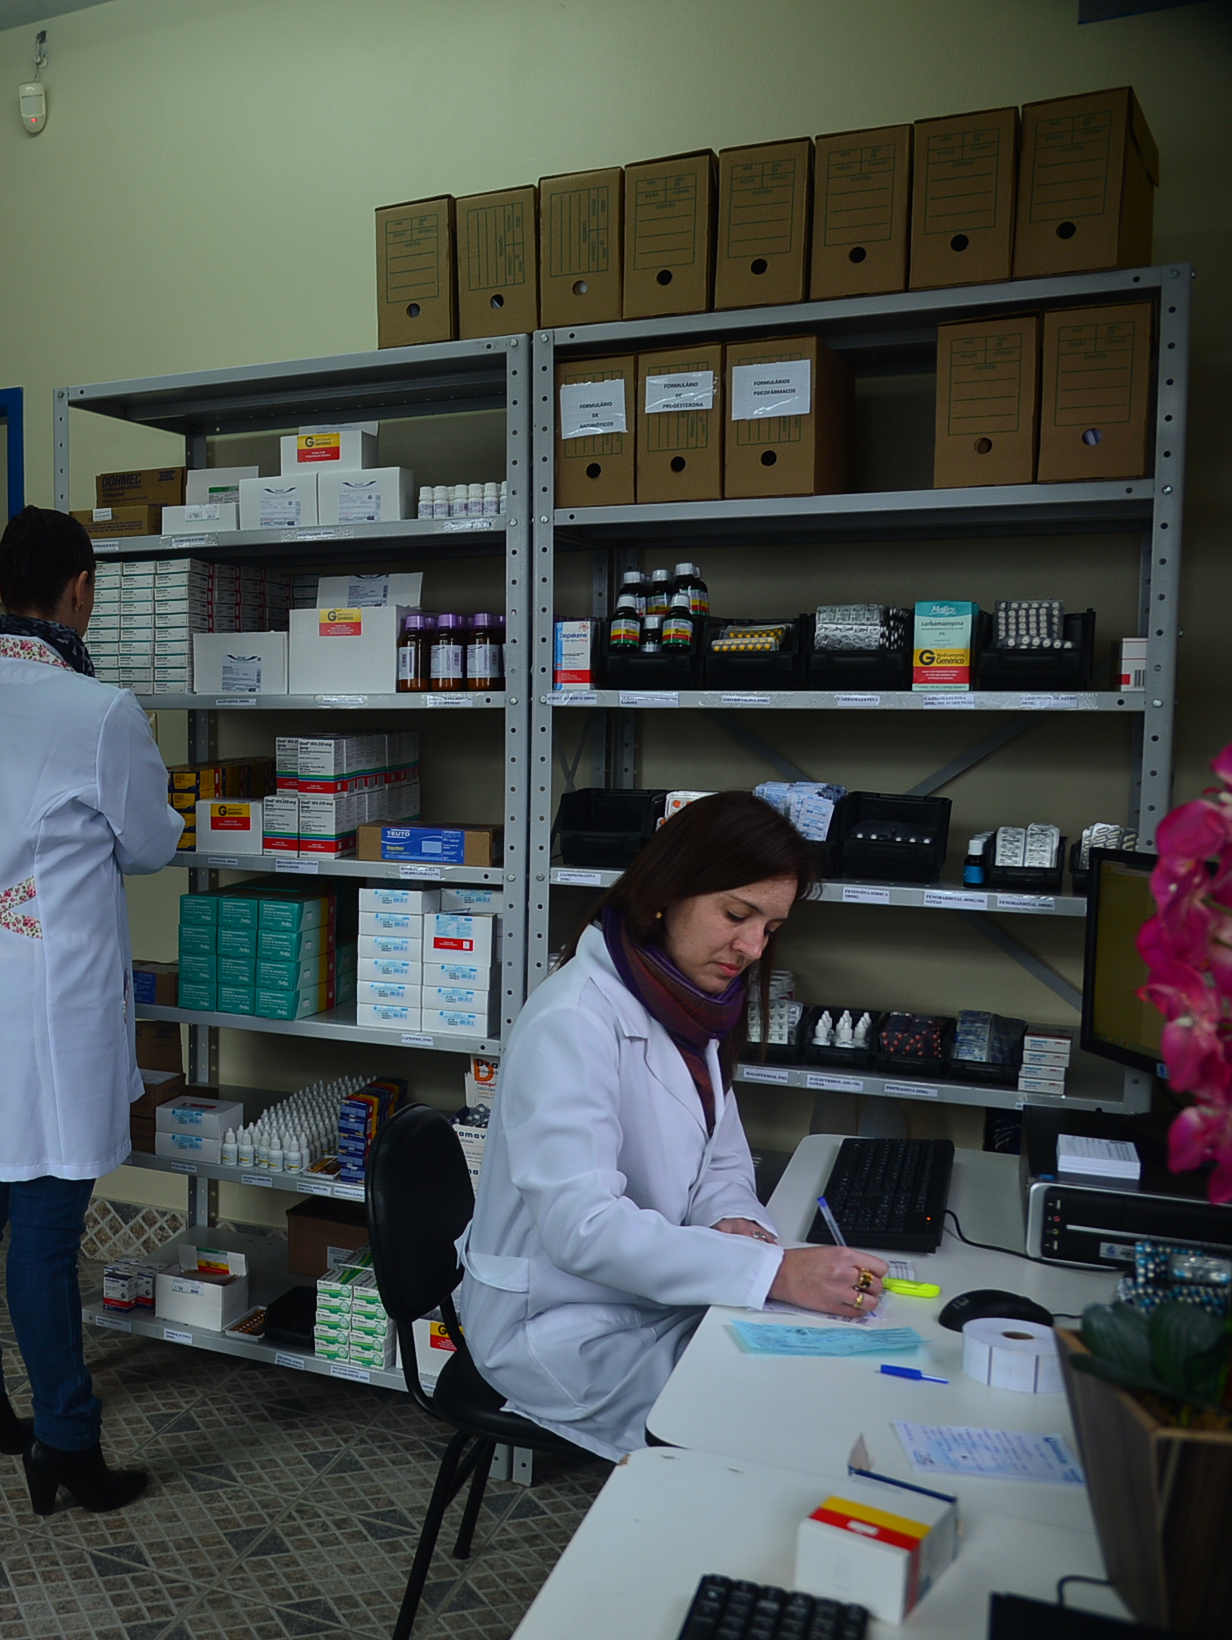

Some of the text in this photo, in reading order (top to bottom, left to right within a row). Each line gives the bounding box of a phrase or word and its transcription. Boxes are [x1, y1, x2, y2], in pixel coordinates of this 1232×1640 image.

[754, 378, 790, 386] FORMULÁRIOS
[754, 388, 796, 396] PSICOFÁRMACOS
[101, 473, 141, 488] DORMEC
[919, 649, 936, 666] G
[218, 805, 227, 816] G
[458, 1131, 486, 1139] amav
